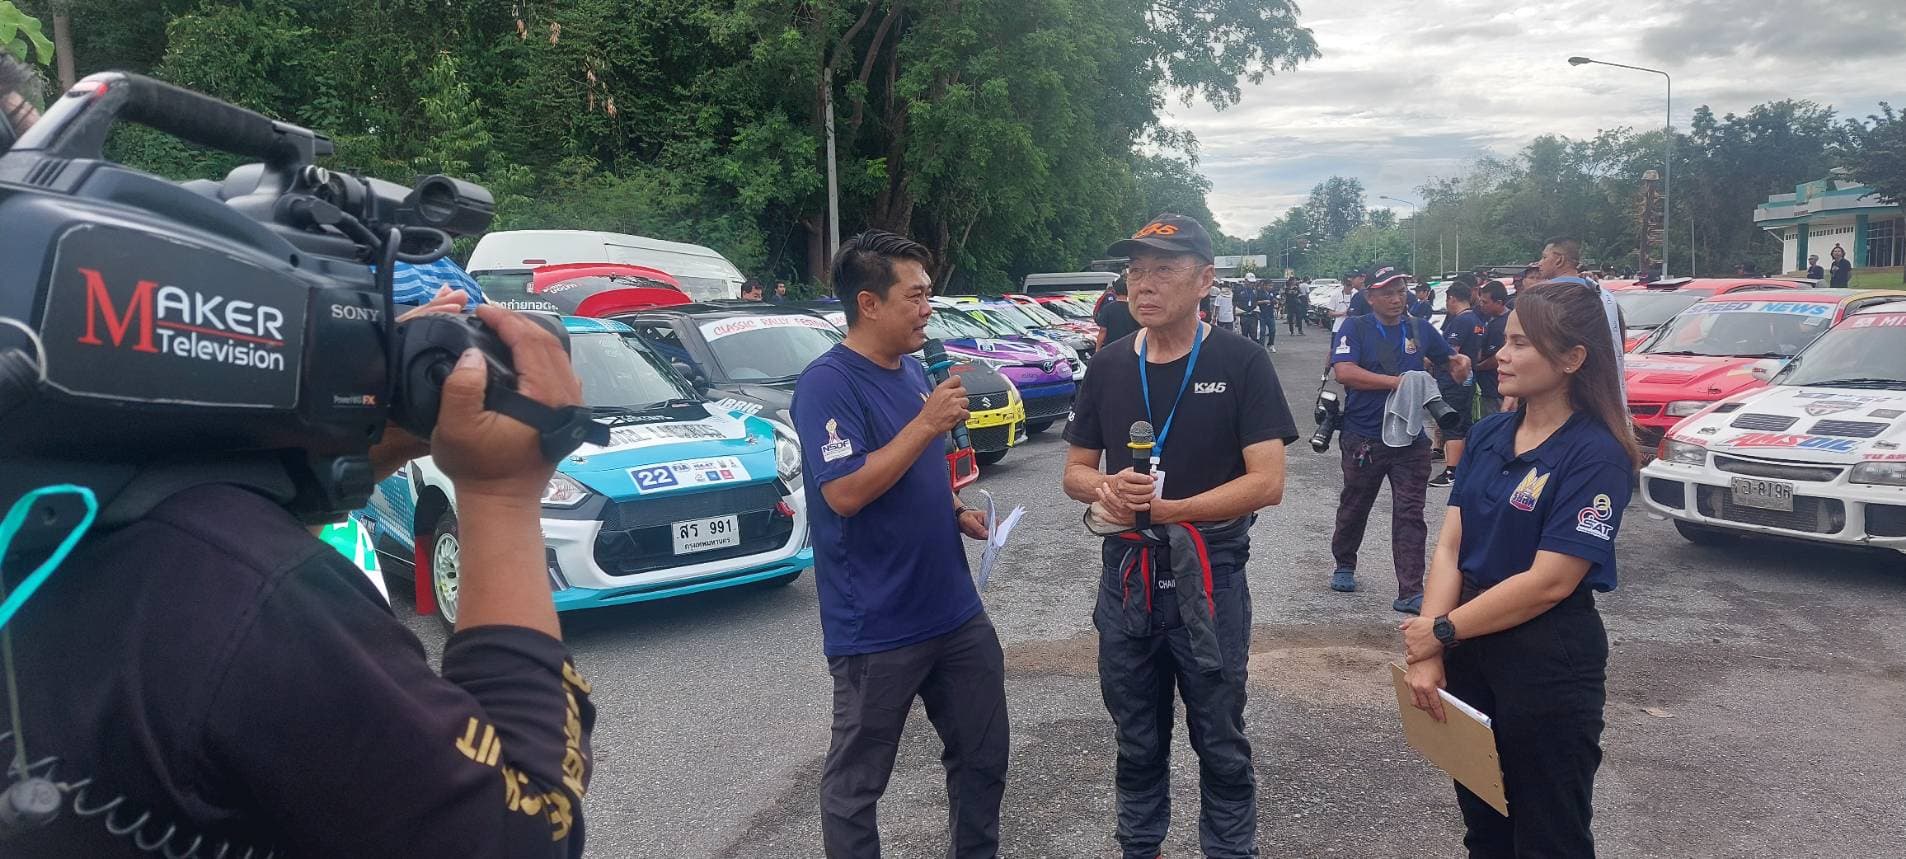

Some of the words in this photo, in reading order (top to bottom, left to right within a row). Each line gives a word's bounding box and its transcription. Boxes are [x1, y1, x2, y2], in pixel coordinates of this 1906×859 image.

[77, 267, 284, 353] MAKER
[331, 304, 379, 321] SONY
[1690, 302, 1752, 314] SPEED
[1759, 302, 1831, 315] NEWS
[713, 320, 755, 336] CLASSIC
[156, 328, 284, 371] Television
[638, 468, 673, 487] 22
[680, 524, 698, 539] สร
[709, 518, 732, 535] 991
[1579, 519, 1613, 537] SAT
